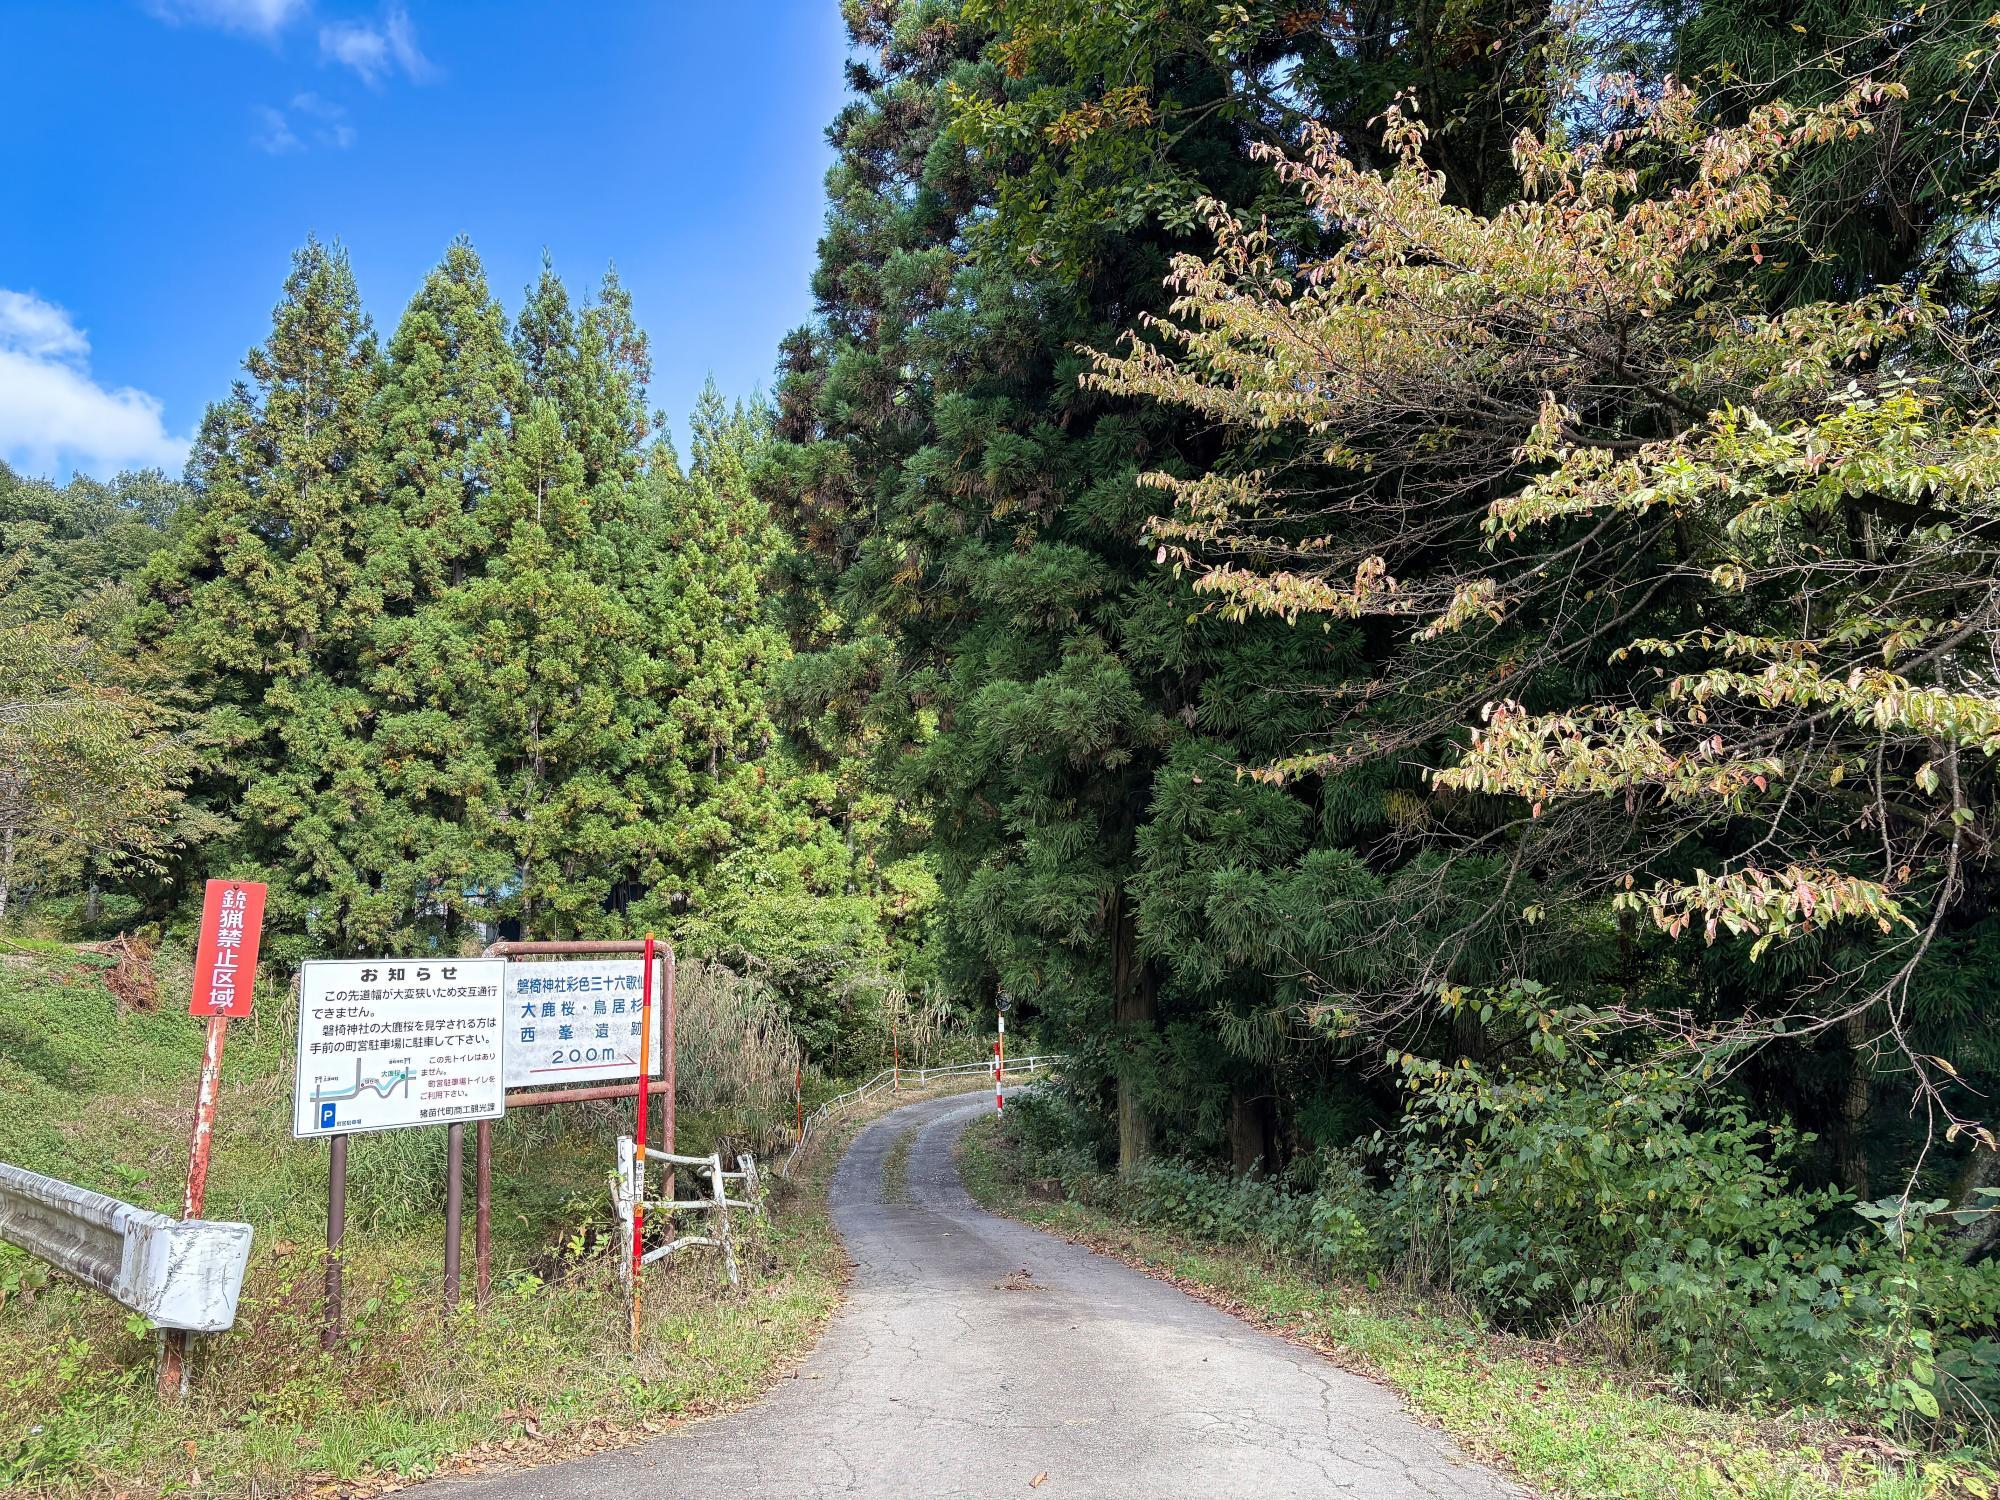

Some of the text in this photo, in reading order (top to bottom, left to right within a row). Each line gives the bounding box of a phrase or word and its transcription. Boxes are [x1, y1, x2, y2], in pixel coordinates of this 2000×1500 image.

[208, 889, 247, 1008] 銃猟禁止区域
[361, 967, 458, 982] お知らせ
[325, 986, 498, 1002] この先道幅が大変狭いため交互通行
[312, 1006, 375, 1020] できません。
[322, 1017, 497, 1037] 磐椅神社の大鹿桜を見学される方は
[309, 1034, 490, 1055] 手前の町営駐車場に駐車して下さい。
[429, 1053, 496, 1064] この先トイレはあり
[552, 1048, 615, 1064] 200m
[421, 1068, 447, 1076] ません。
[420, 1090, 468, 1100] ご利用下さい。
[323, 1110, 333, 1121] P
